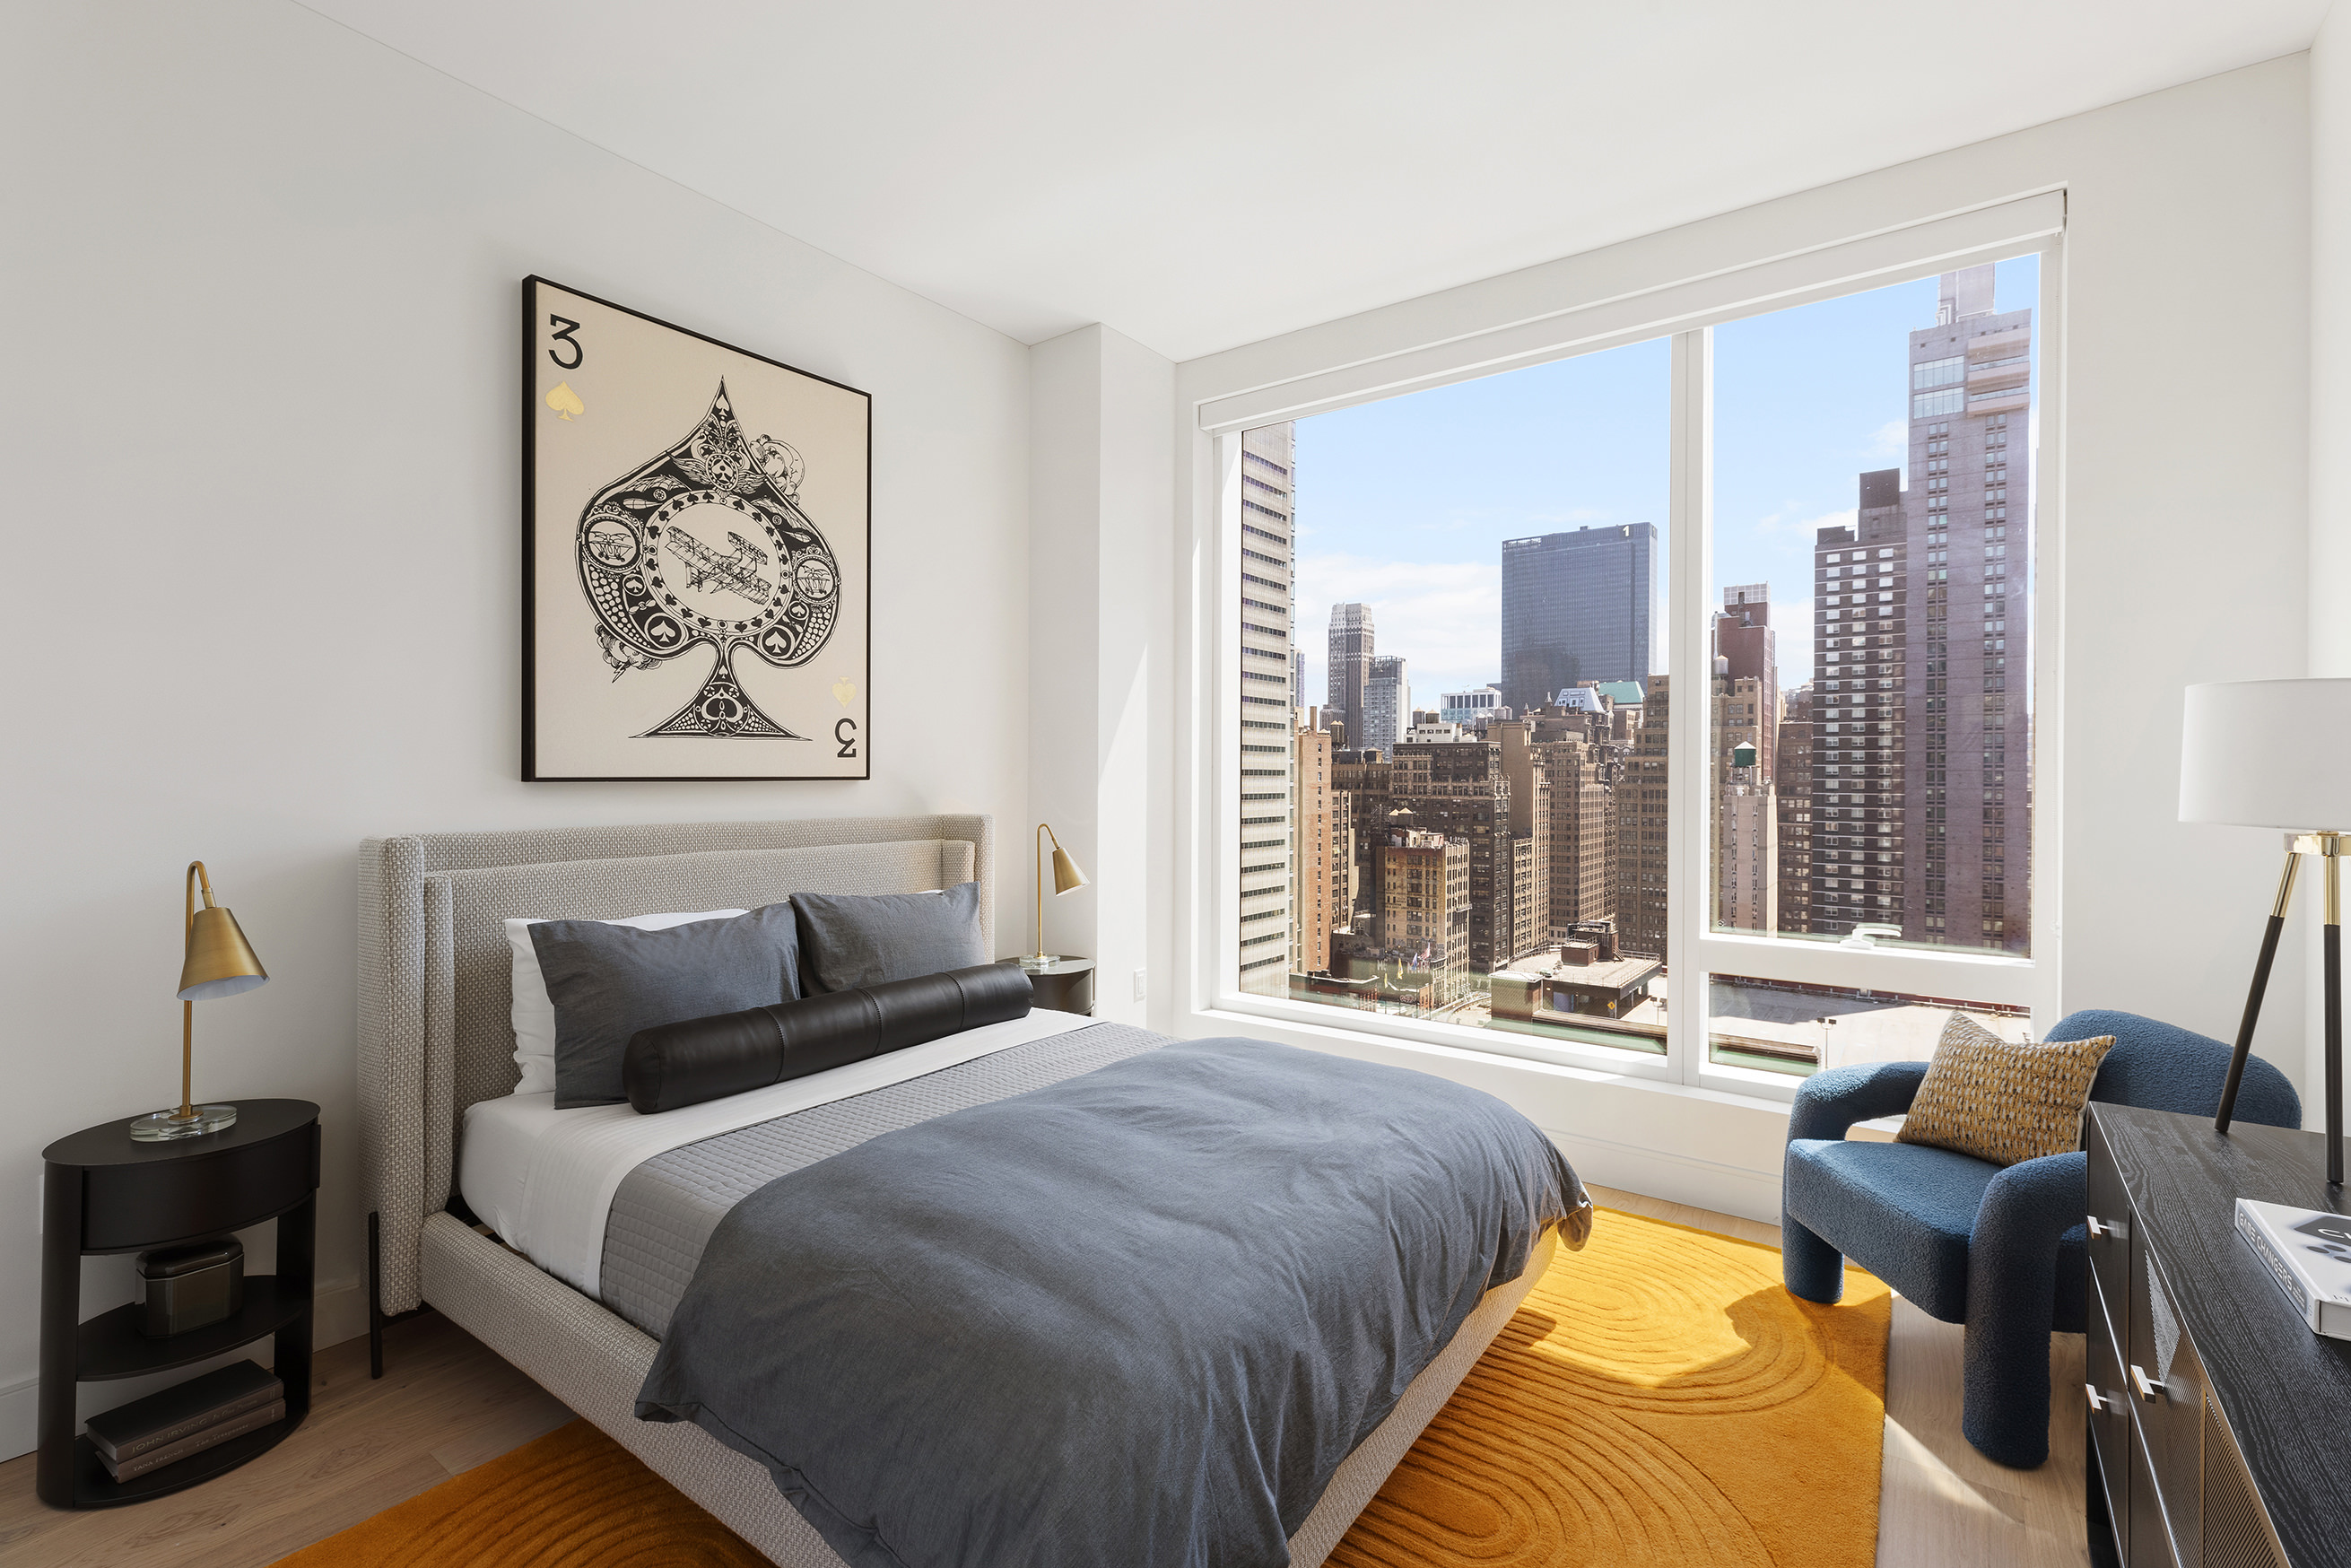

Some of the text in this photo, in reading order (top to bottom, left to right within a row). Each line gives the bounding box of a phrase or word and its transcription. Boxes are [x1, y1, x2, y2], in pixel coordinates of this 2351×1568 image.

[549, 314, 583, 370] 3
[1623, 526, 1630, 536] 1
[835, 719, 857, 757] 3
[2239, 1212, 2293, 1291] GAME CHANGERS
[132, 1418, 207, 1453] JOHN IRVING
[195, 1439, 210, 1448] The
[133, 1460, 153, 1472] TANA
